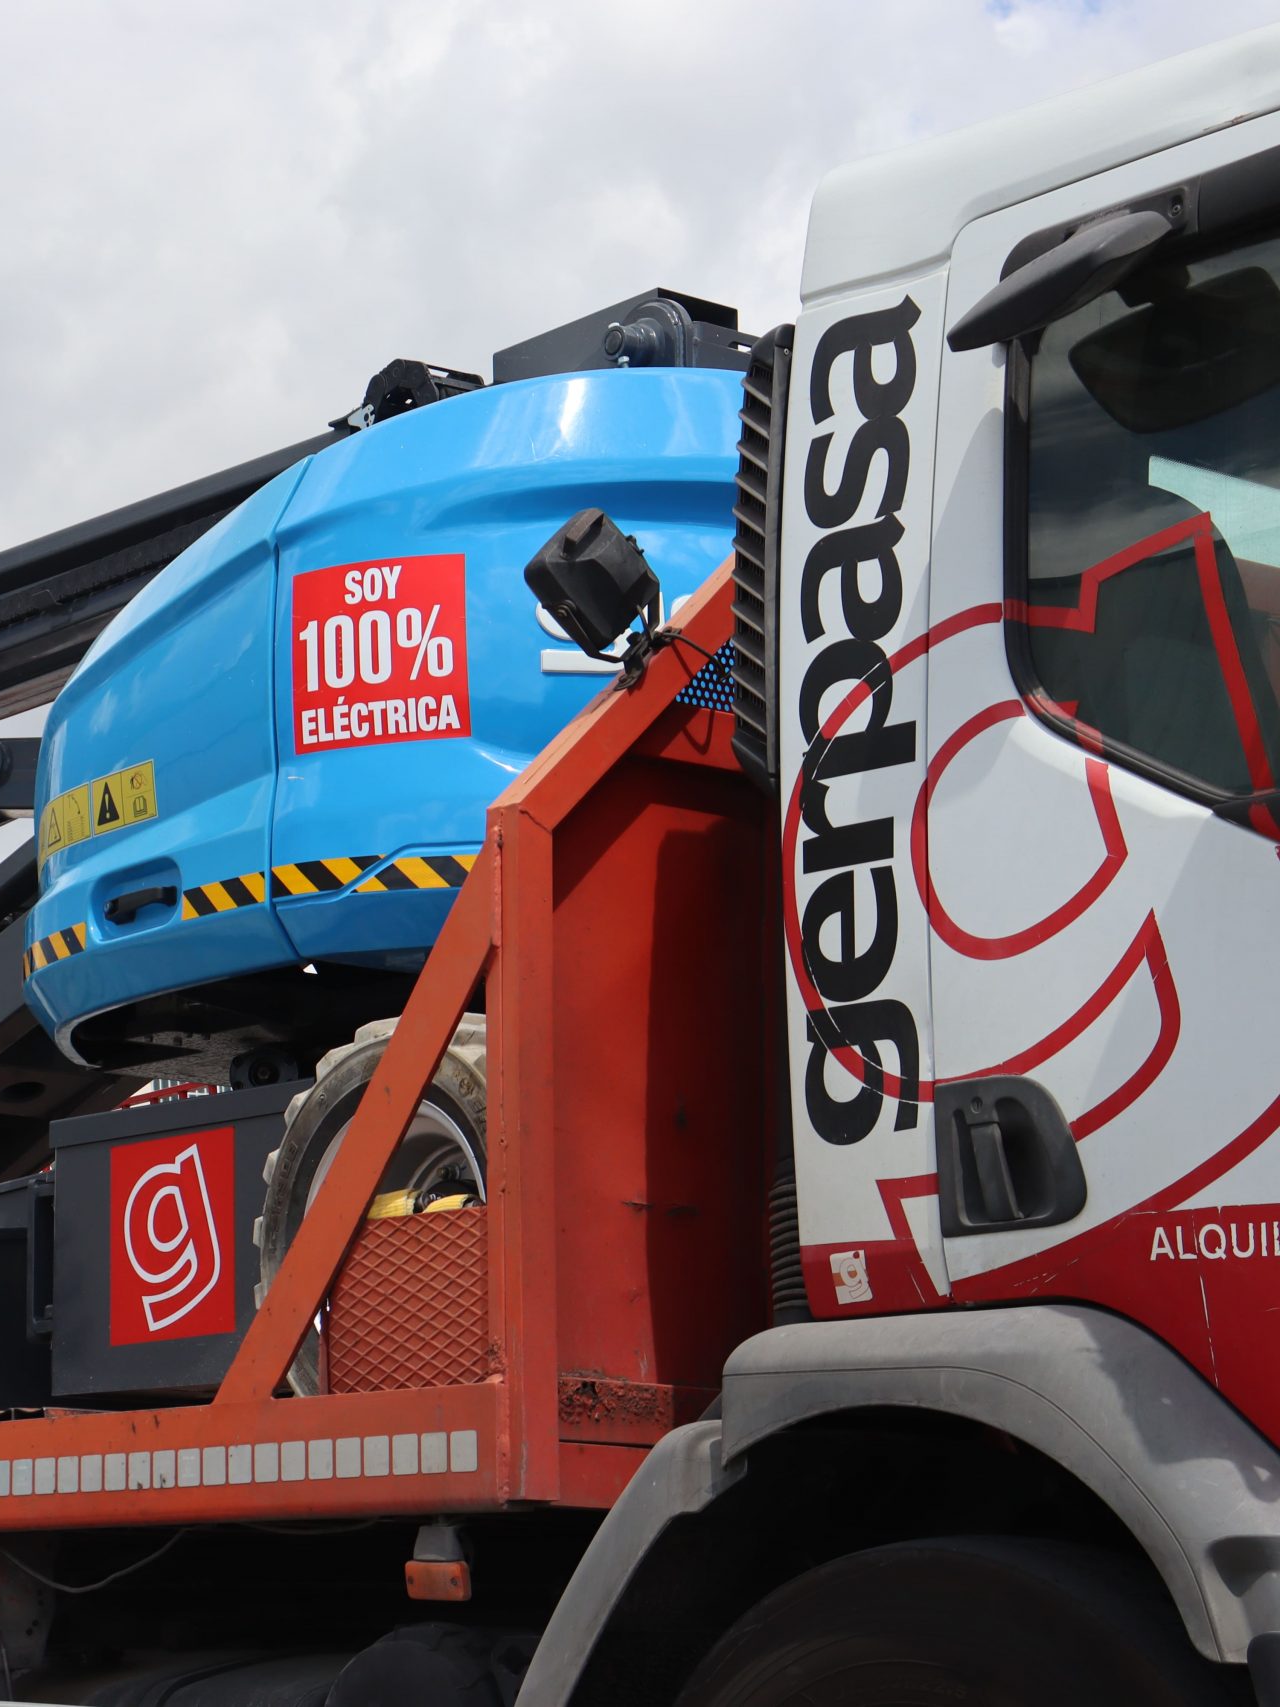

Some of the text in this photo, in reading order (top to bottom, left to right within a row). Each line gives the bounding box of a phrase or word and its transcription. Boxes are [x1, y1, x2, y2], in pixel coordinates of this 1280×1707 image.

[344, 565, 402, 605] SOY
[299, 604, 454, 692] 100%
[301, 695, 461, 745] ELÉCTRICA
[799, 294, 922, 1146] gerpasa
